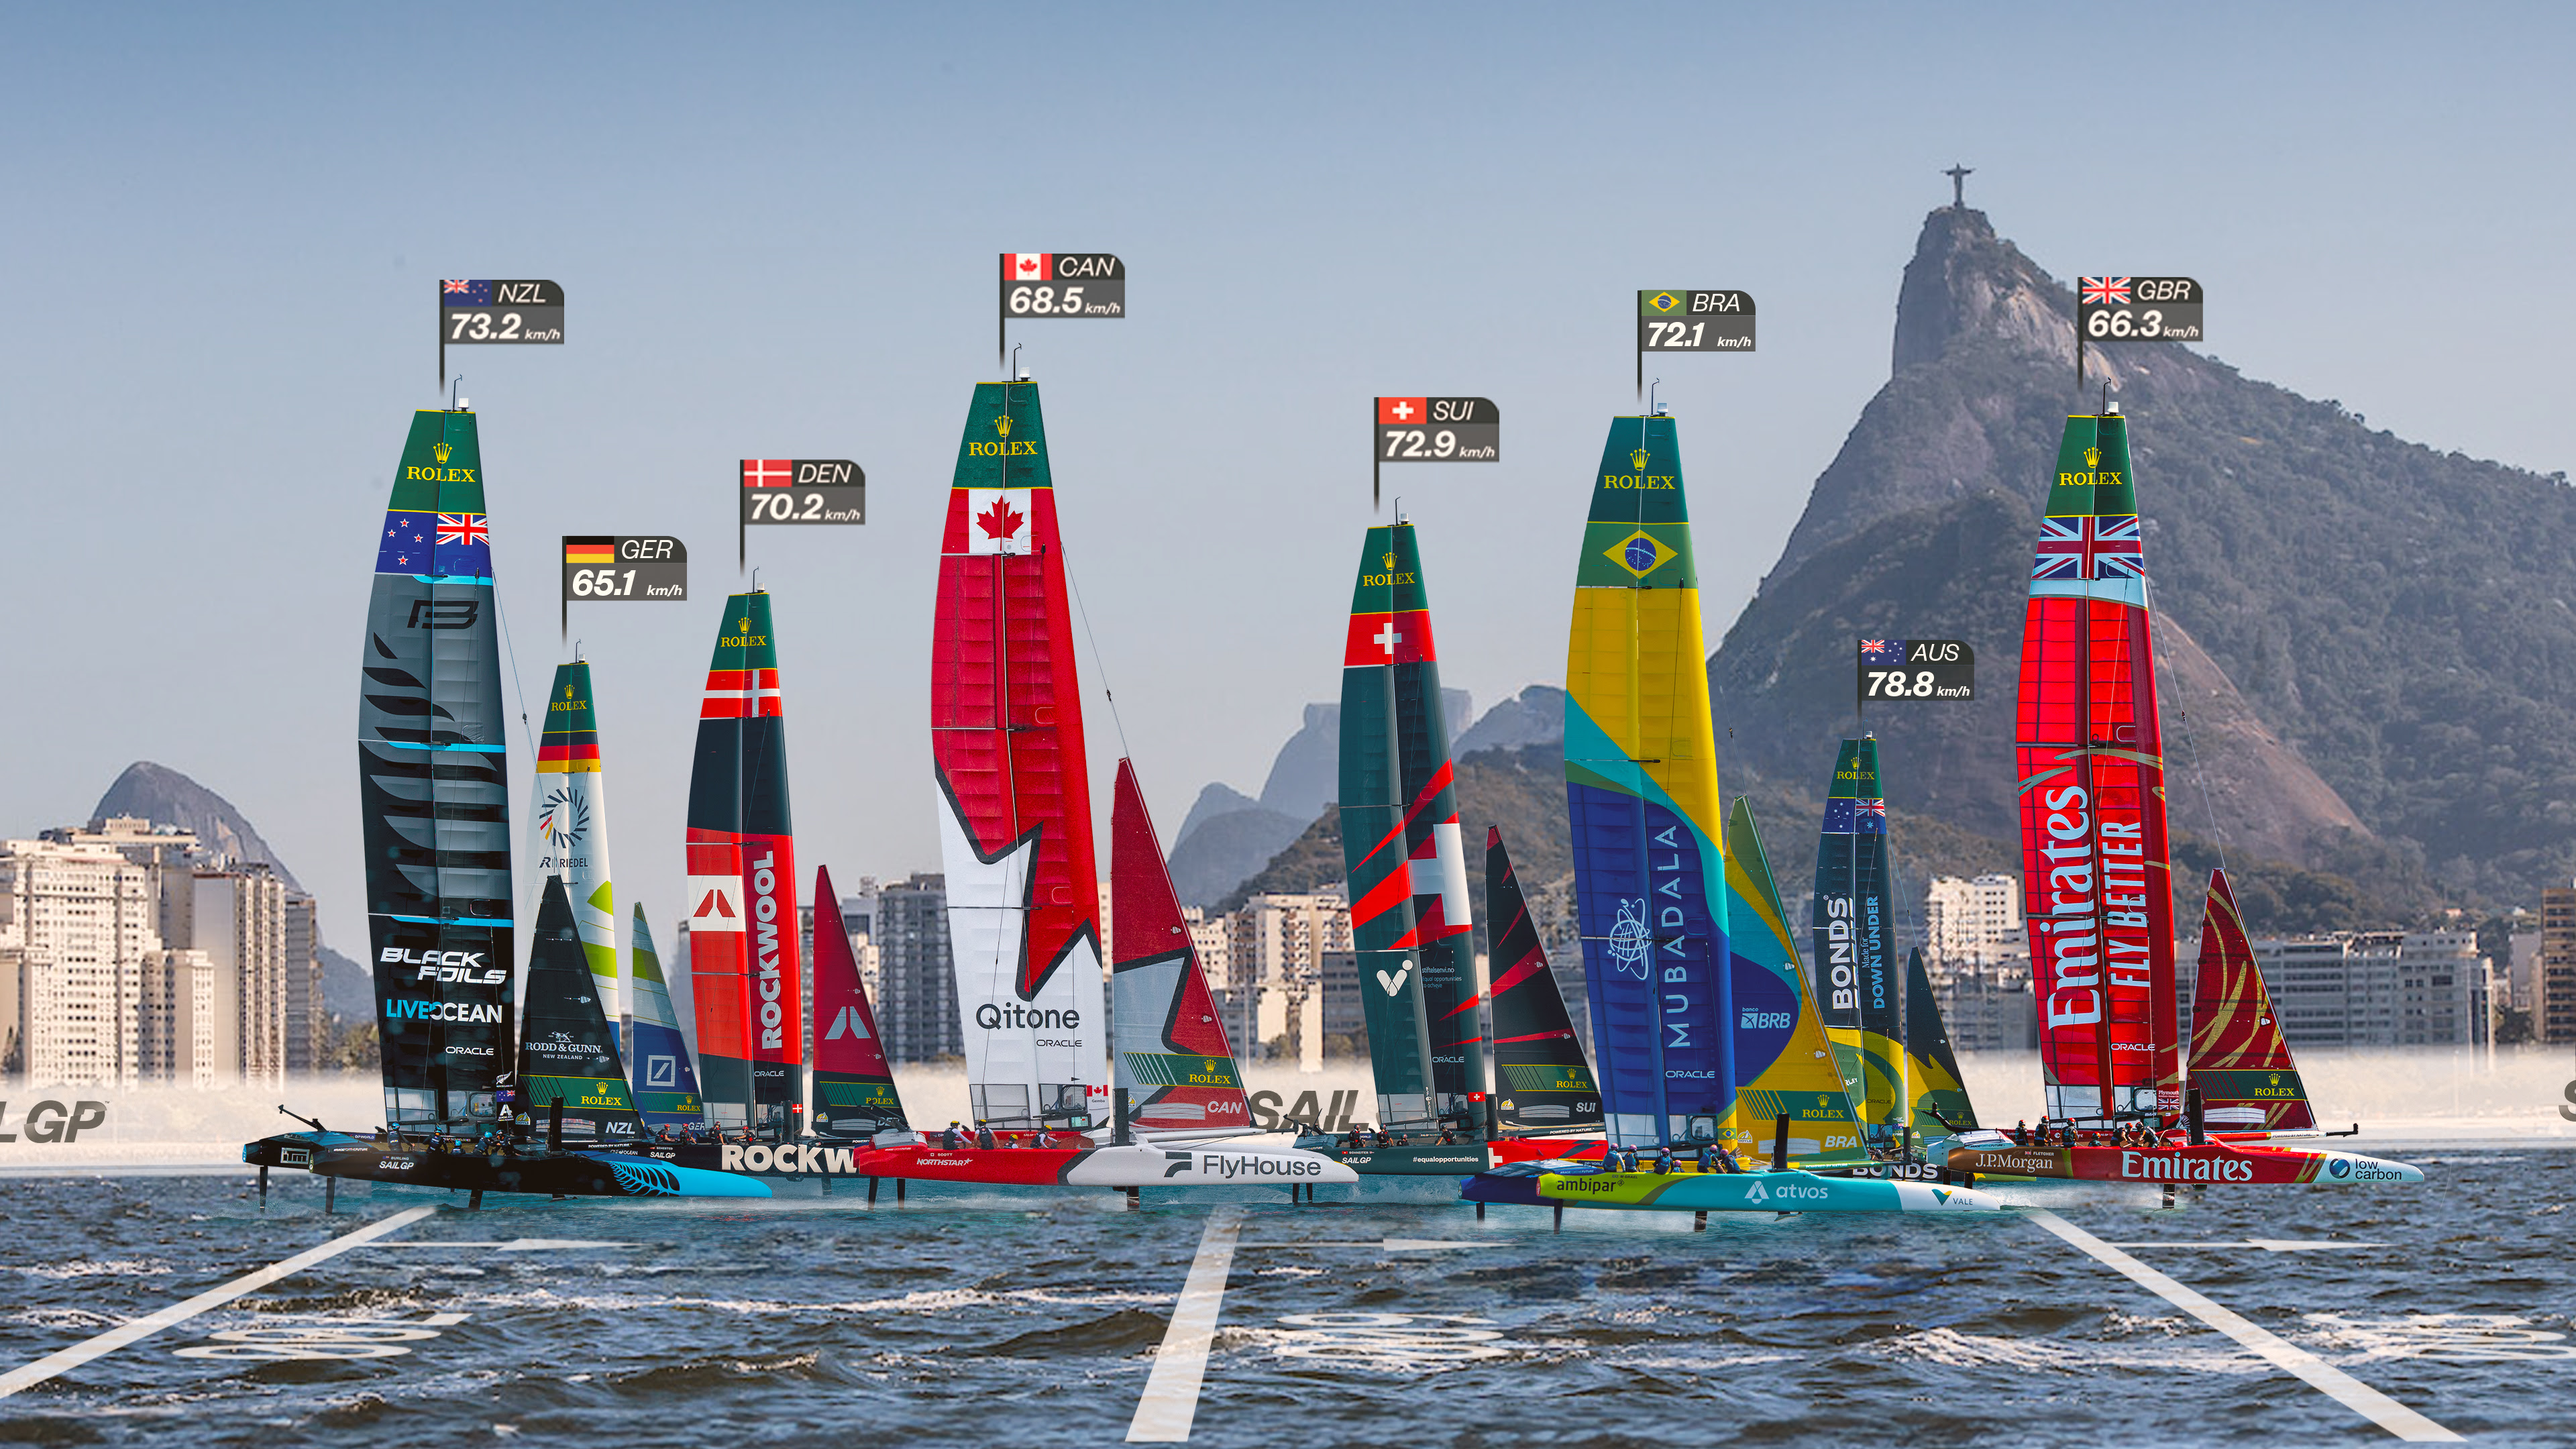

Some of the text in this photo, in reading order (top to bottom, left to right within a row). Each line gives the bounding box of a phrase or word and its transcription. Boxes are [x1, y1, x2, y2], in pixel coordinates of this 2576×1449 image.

[969, 441, 1038, 456] ROLEX
[407, 466, 476, 482] ROLEX
[2059, 472, 2123, 486] ROLEX
[1603, 475, 1676, 490] ROLEX
[1362, 572, 1415, 587] ROLEX
[720, 635, 767, 647] ROLEX
[551, 699, 587, 712] ROLEX
[1837, 771, 1874, 780] ROLEX
[559, 857, 588, 867] RIEDEL
[2039, 786, 2101, 1030] Emirates
[2101, 822, 2151, 987] FLY BETTER
[1654, 825, 1690, 1048] MUBADALA
[753, 851, 782, 1050] ROCKWOOL
[1827, 896, 1854, 1010] BONDS
[1862, 945, 1870, 969] Made
[1867, 896, 1886, 1009] DOWN UNDER
[380, 947, 486, 968] BLACK
[417, 965, 507, 985] FOILS
[975, 1002, 1080, 1030] Qitone
[1758, 1012, 1791, 1029] BRB
[525, 1042, 557, 1052] RODD
[559, 1044, 567, 1052] &
[1036, 1039, 1082, 1047] ORACLE
[2111, 1043, 2155, 1051] ORACLE
[445, 1046, 494, 1056] ORACLE
[754, 1070, 784, 1078] ORACLE
[1189, 1074, 1231, 1085] ROLEX
[1665, 1069, 1715, 1079] ORACLE
[1556, 1080, 1588, 1089] ROLEX
[2254, 1087, 2294, 1097] ROLEX
[581, 1095, 622, 1106] ROLEX
[1207, 1100, 1242, 1114] CAN
[1576, 1102, 1597, 1113] SUI
[1803, 1109, 1844, 1118] ROLEX
[604, 1121, 636, 1135] NZL
[688, 1122, 705, 1130] GER
[1825, 1136, 1858, 1148] BRA
[650, 1151, 676, 1159] SAILGP
[721, 1144, 857, 1174] ROCKW
[1413, 1156, 1479, 1164] #equalopportunities
[379, 1161, 415, 1170] SAILGP
[916, 1158, 963, 1166] NORTHSTAR
[1203, 1155, 1321, 1179] FlyHouse
[1976, 1153, 2053, 1173] J.P.Morgan
[2122, 1151, 2253, 1181] Emirates
[2355, 1158, 2378, 1169] low
[1853, 1163, 1939, 1179] BONDS
[2355, 1168, 2402, 1181] carbon
[1556, 1178, 1617, 1195] ambipar
[1776, 1183, 1828, 1199] atvos
[1953, 1197, 1973, 1205] VALE
